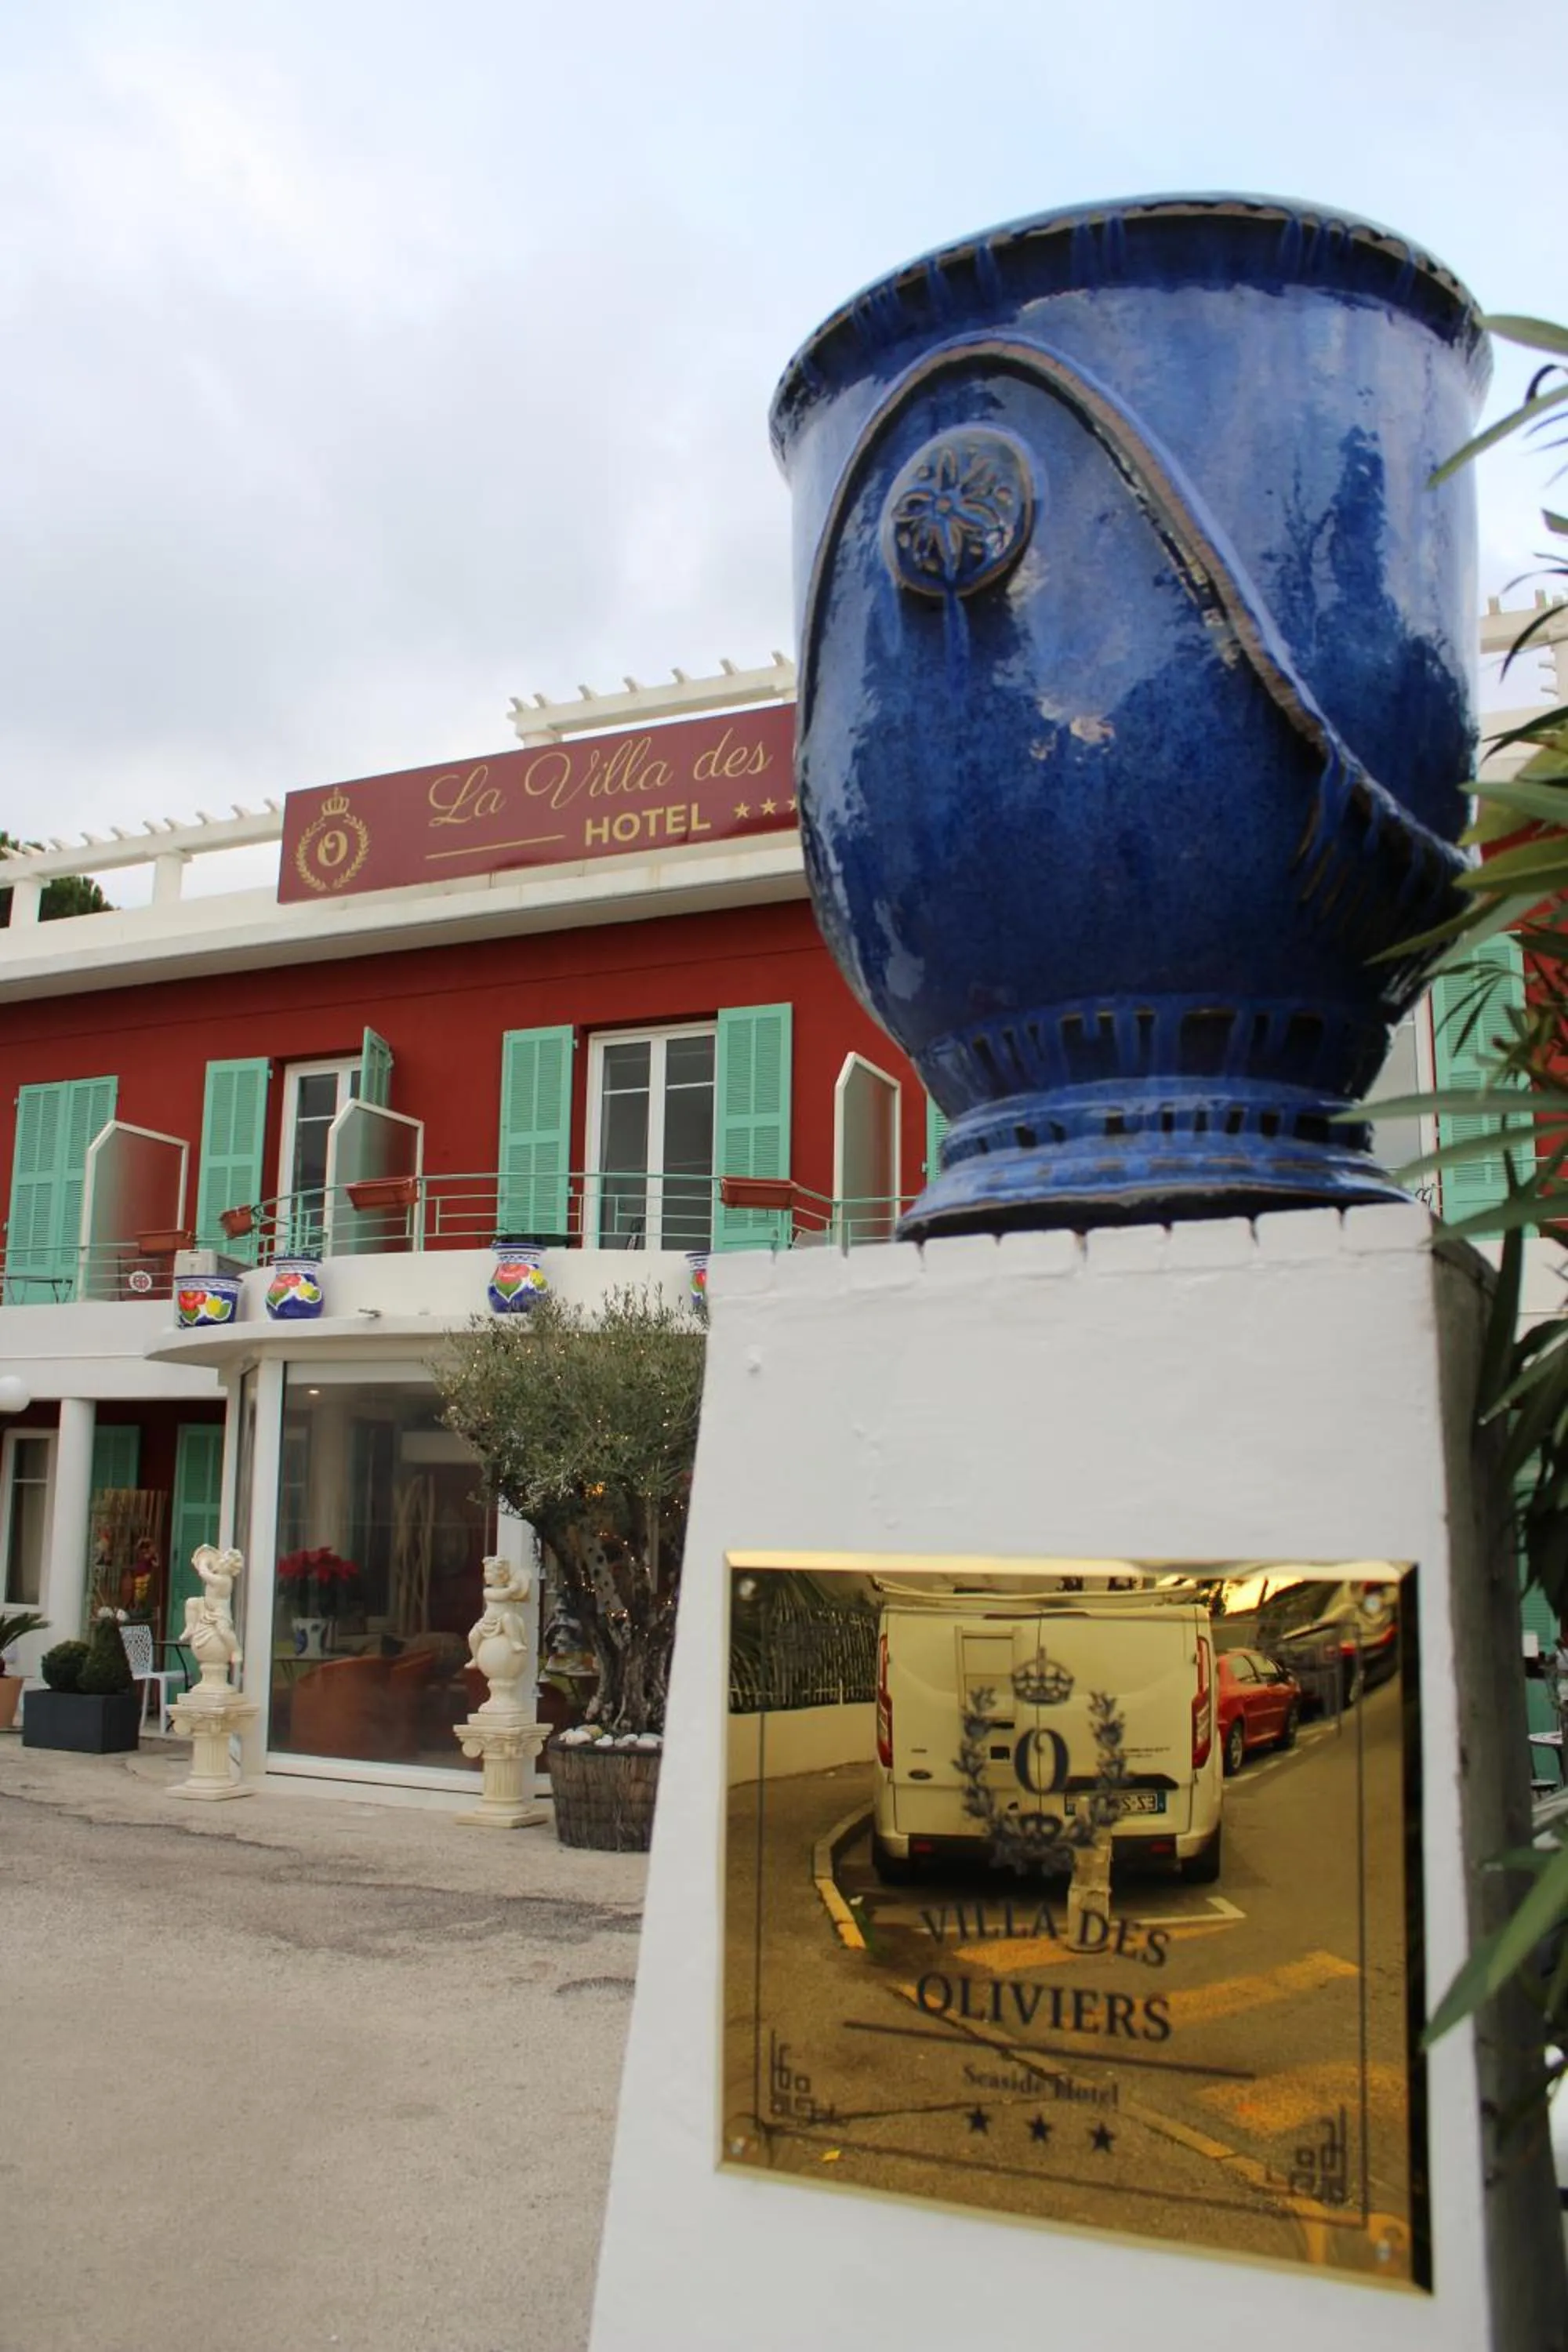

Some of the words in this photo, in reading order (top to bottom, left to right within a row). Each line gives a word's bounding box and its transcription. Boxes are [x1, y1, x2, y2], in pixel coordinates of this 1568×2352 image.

[428, 764, 506, 828] La
[524, 735, 674, 810] Villa
[693, 726, 775, 782] des
[585, 801, 711, 847] HOTEL
[920, 1901, 1058, 1944] VILLA
[1078, 1909, 1171, 1968] DES
[916, 1971, 1172, 2042] OLIVIERS
[1055, 2078, 1119, 2107] Hotel
